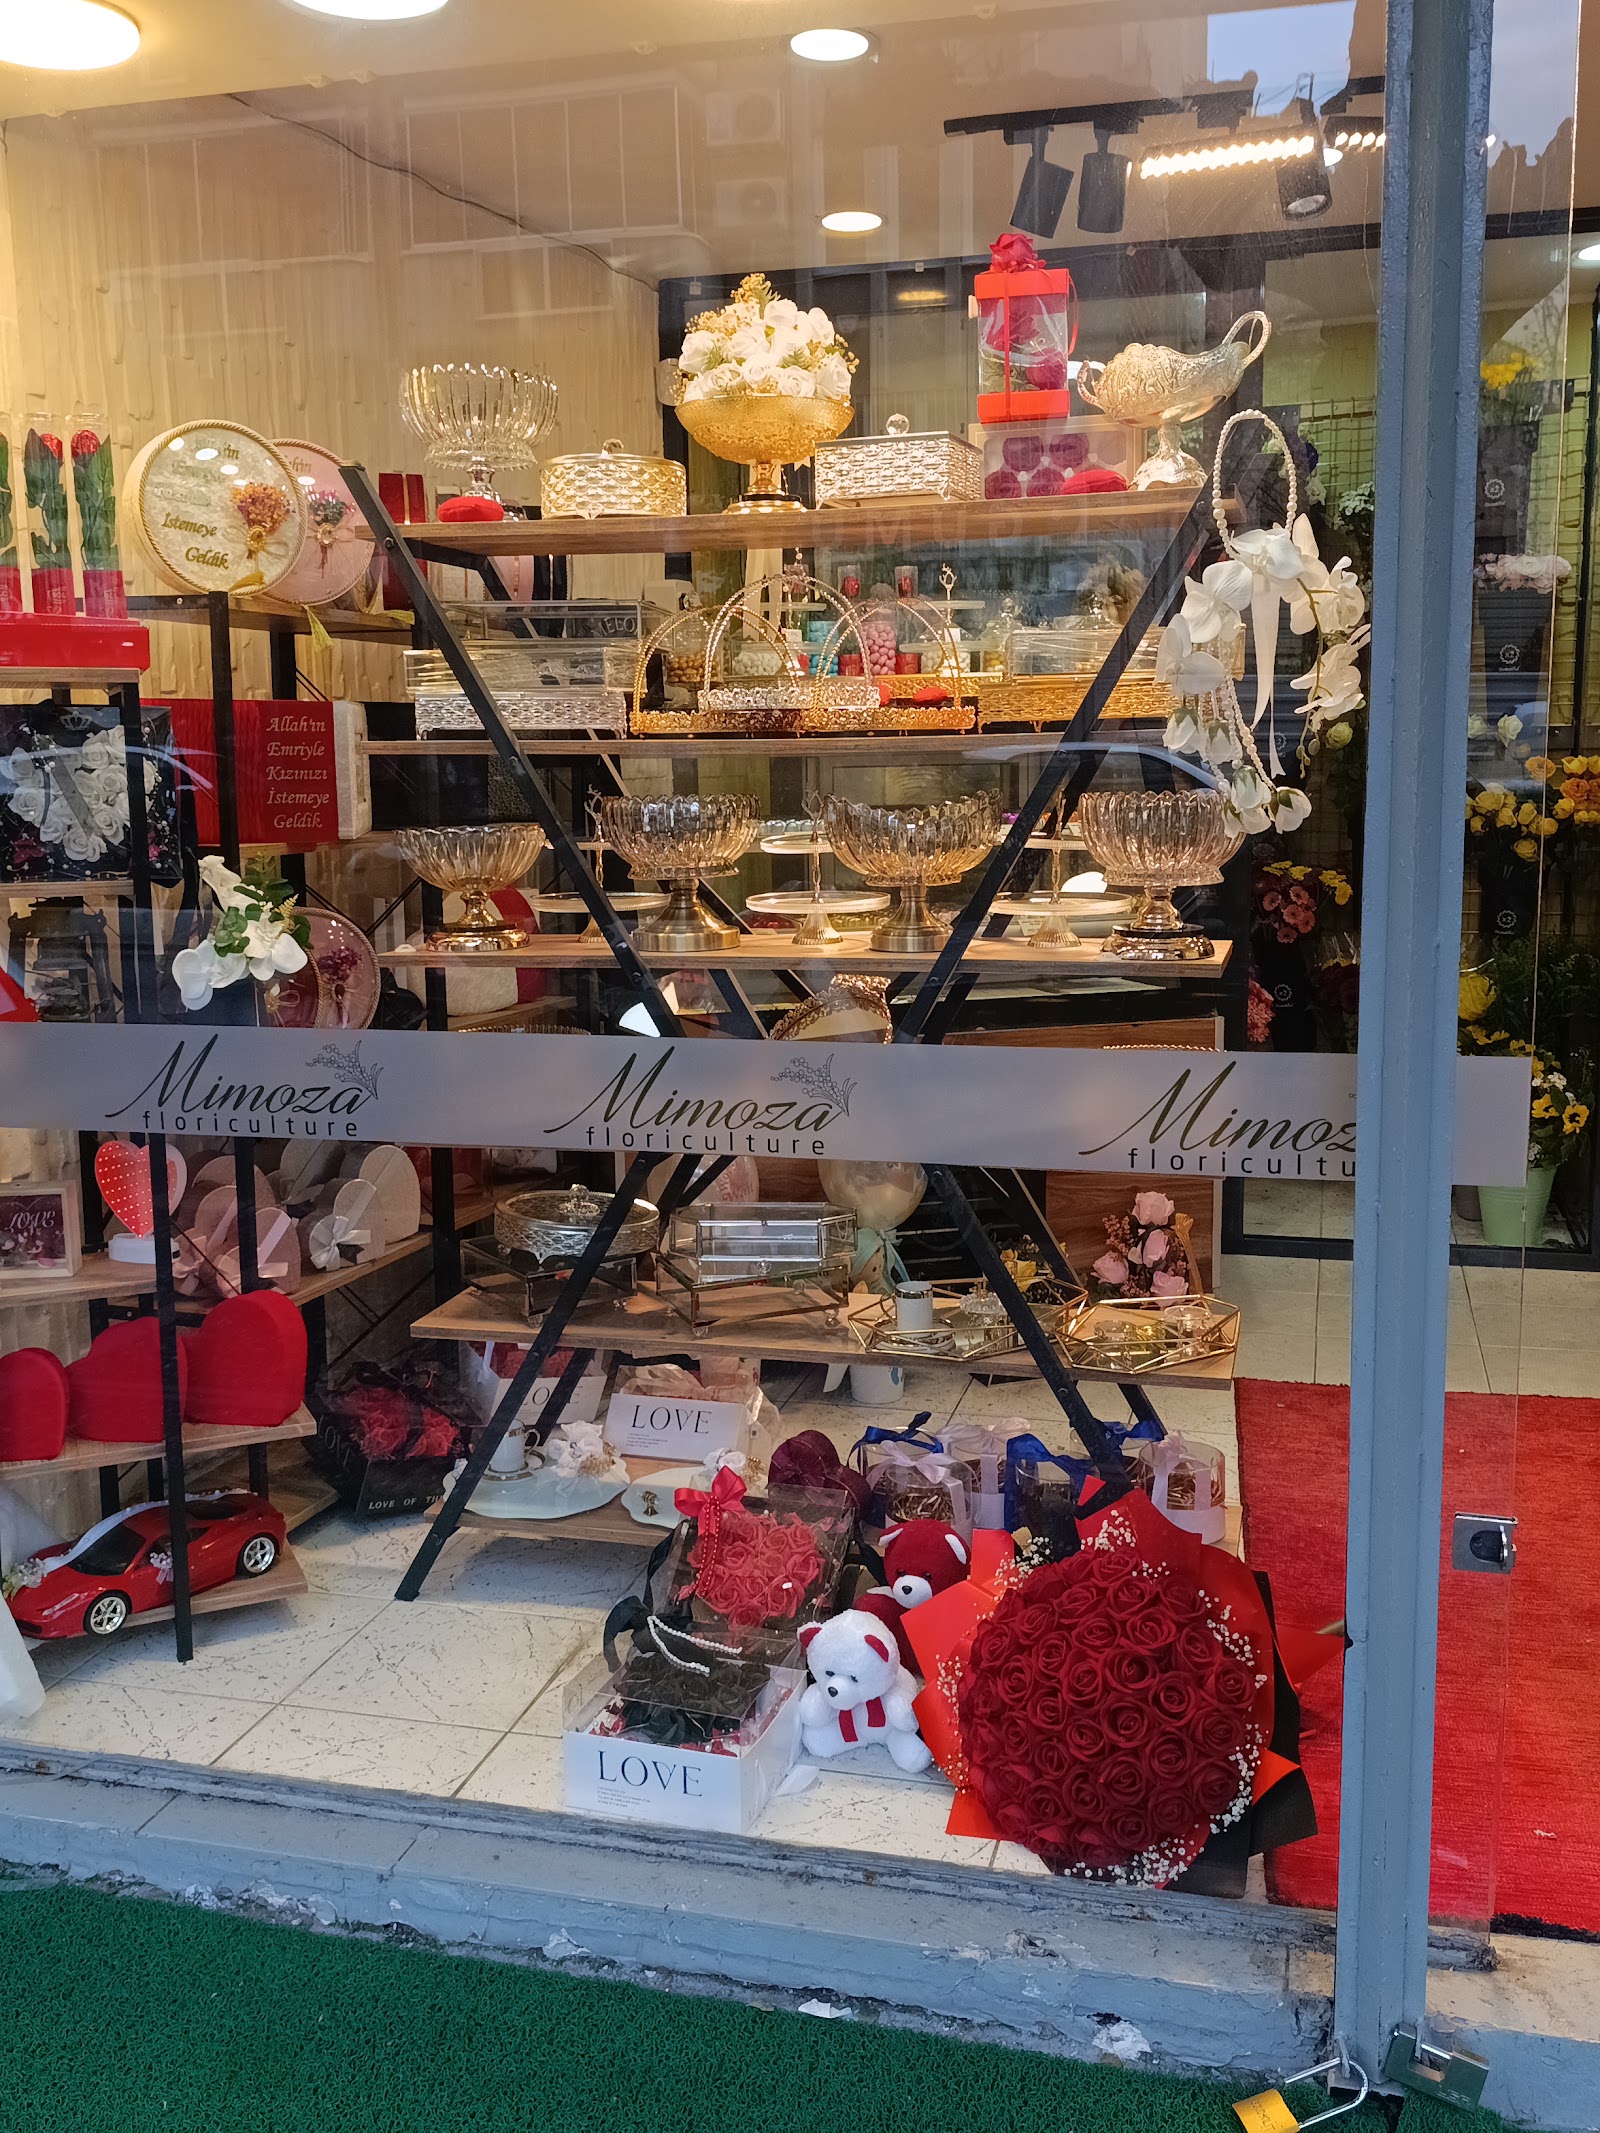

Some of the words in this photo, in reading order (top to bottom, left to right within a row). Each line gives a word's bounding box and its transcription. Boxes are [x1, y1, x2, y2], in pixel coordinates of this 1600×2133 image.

[185, 546, 230, 570] Geldik
[266, 740, 326, 761] Emriyle
[266, 765, 328, 781] Kızınızı
[266, 786, 330, 808] İstemeye
[273, 812, 323, 828] Geldik
[104, 1033, 372, 1118] Mimoza
[543, 1045, 843, 1133] Mimoza
[1078, 1060, 1357, 1155] Mimoz
[142, 1111, 358, 1137] floriculture
[585, 1126, 825, 1155] floriculture
[1127, 1148, 1356, 1177] floricultu
[9, 1210, 56, 1232] LOVE
[631, 1404, 713, 1434] LOVE
[368, 1500, 395, 1510] LOVE
[403, 1497, 418, 1506] OF
[598, 1750, 703, 1797] LOVE
